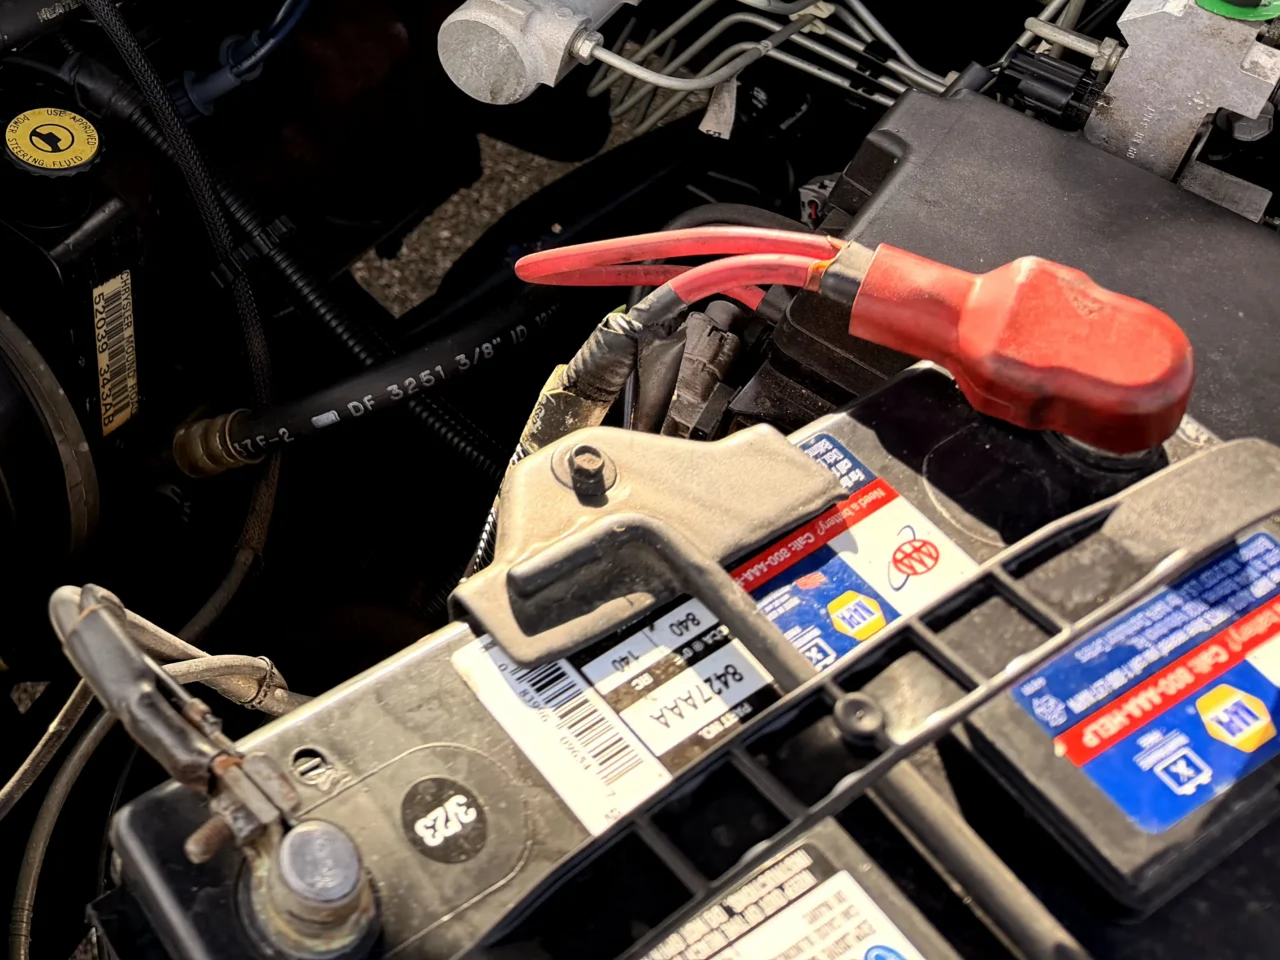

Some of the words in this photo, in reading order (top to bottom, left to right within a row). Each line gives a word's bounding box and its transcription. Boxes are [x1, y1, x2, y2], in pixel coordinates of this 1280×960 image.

[9, 114, 30, 134] POWER
[46, 108, 66, 118] USE
[69, 115, 97, 146] APPROVED
[7, 137, 45, 167] STEERING
[52, 155, 83, 168] FLUID
[120, 271, 133, 330] CHRYSLER
[94, 292, 109, 355] 52039
[124, 334, 137, 379] MOUND
[347, 394, 375, 417] DF
[386, 364, 447, 401] 3251
[455, 337, 501, 371] 3/8"
[510, 325, 527, 345] ID
[99, 364, 115, 428] 343AB
[855, 487, 885, 509] Need
[814, 506, 853, 536] battery?
[787, 531, 815, 553] Call:
[667, 610, 701, 638] 840
[835, 599, 874, 629] NAPA
[701, 624, 729, 645] CCA
[497, 662, 508, 672] 0
[610, 648, 641, 673] 140
[1187, 641, 1228, 676] Call:
[629, 671, 653, 690] RC
[649, 662, 745, 731] 8427AAA
[1079, 664, 1195, 747] 800-AAA-HELP
[717, 701, 752, 727] PART
[414, 794, 477, 847] 3/23
